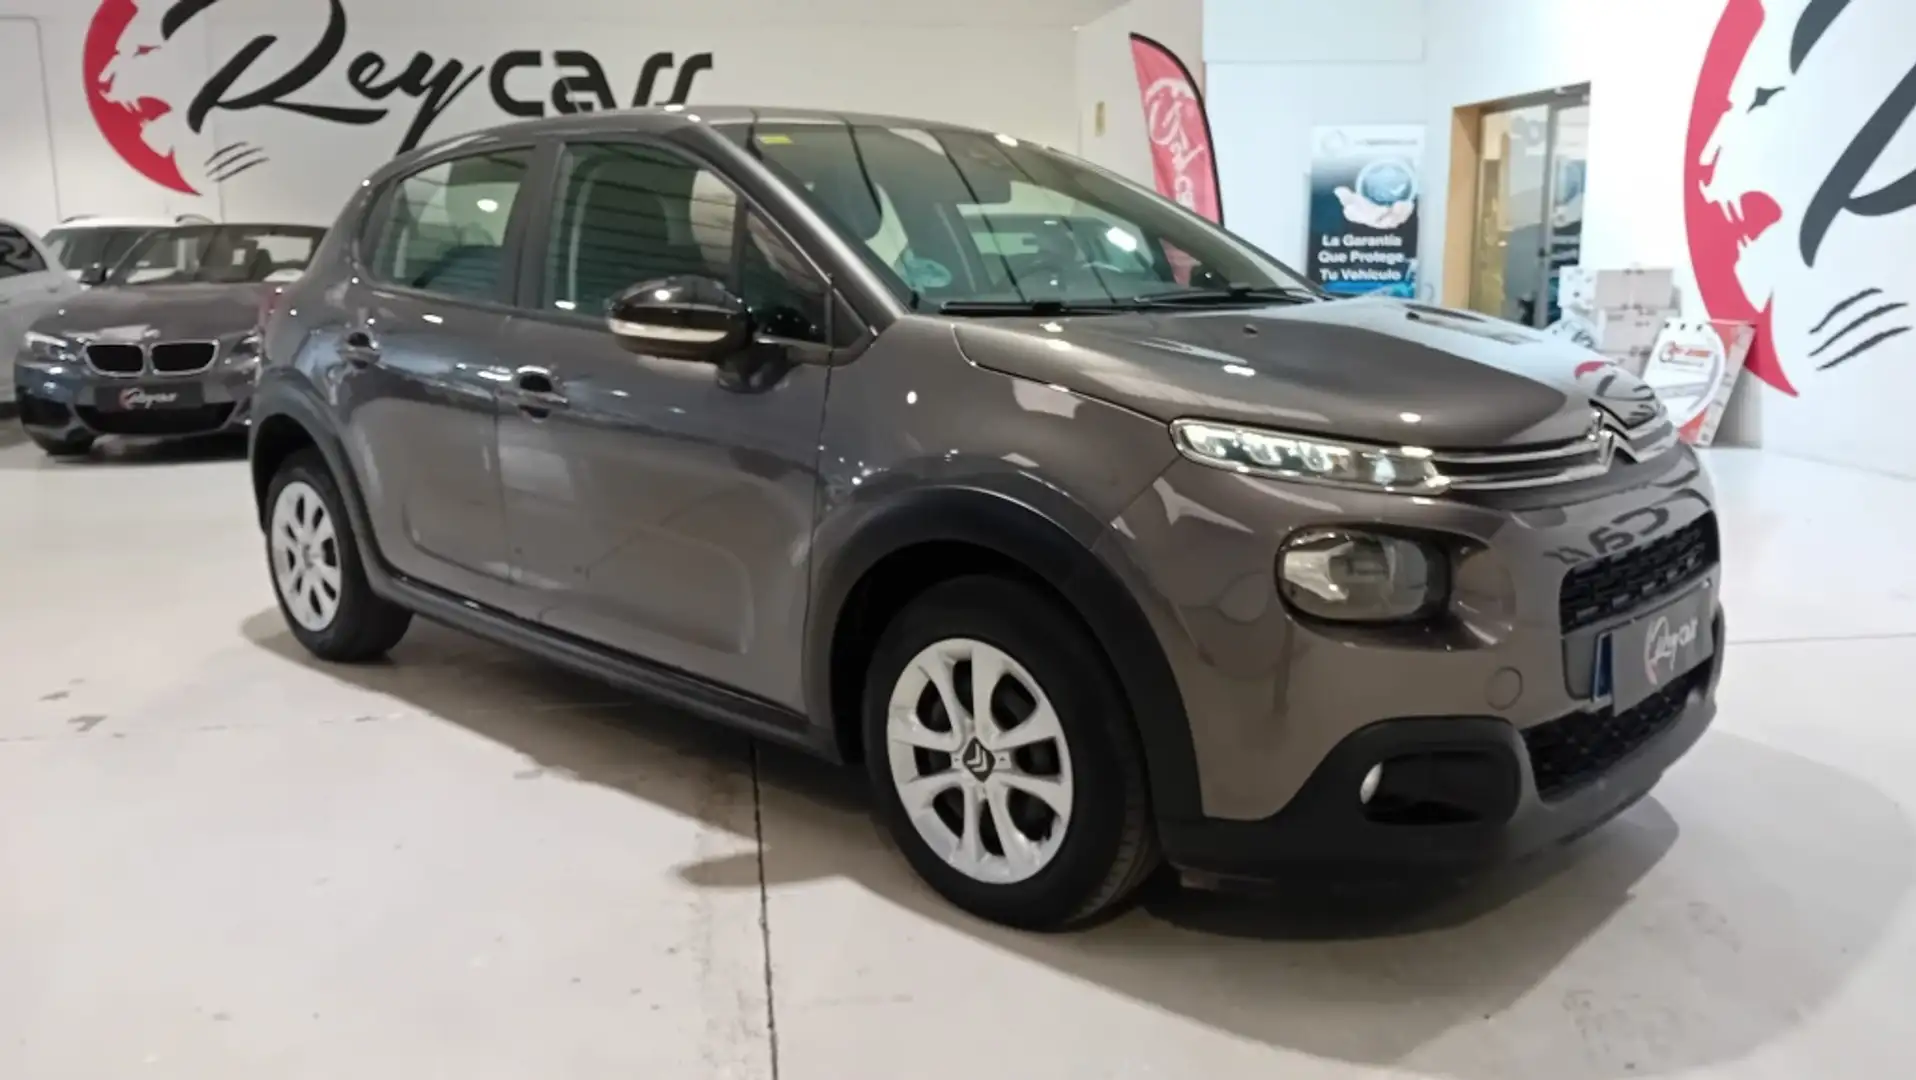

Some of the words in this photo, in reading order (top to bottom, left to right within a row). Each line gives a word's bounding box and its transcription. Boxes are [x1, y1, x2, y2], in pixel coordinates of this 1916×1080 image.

[1322, 234, 1341, 247] La
[1317, 250, 1348, 263] Que
[1350, 250, 1404, 265] Protege
[1319, 268, 1339, 281] Tu
